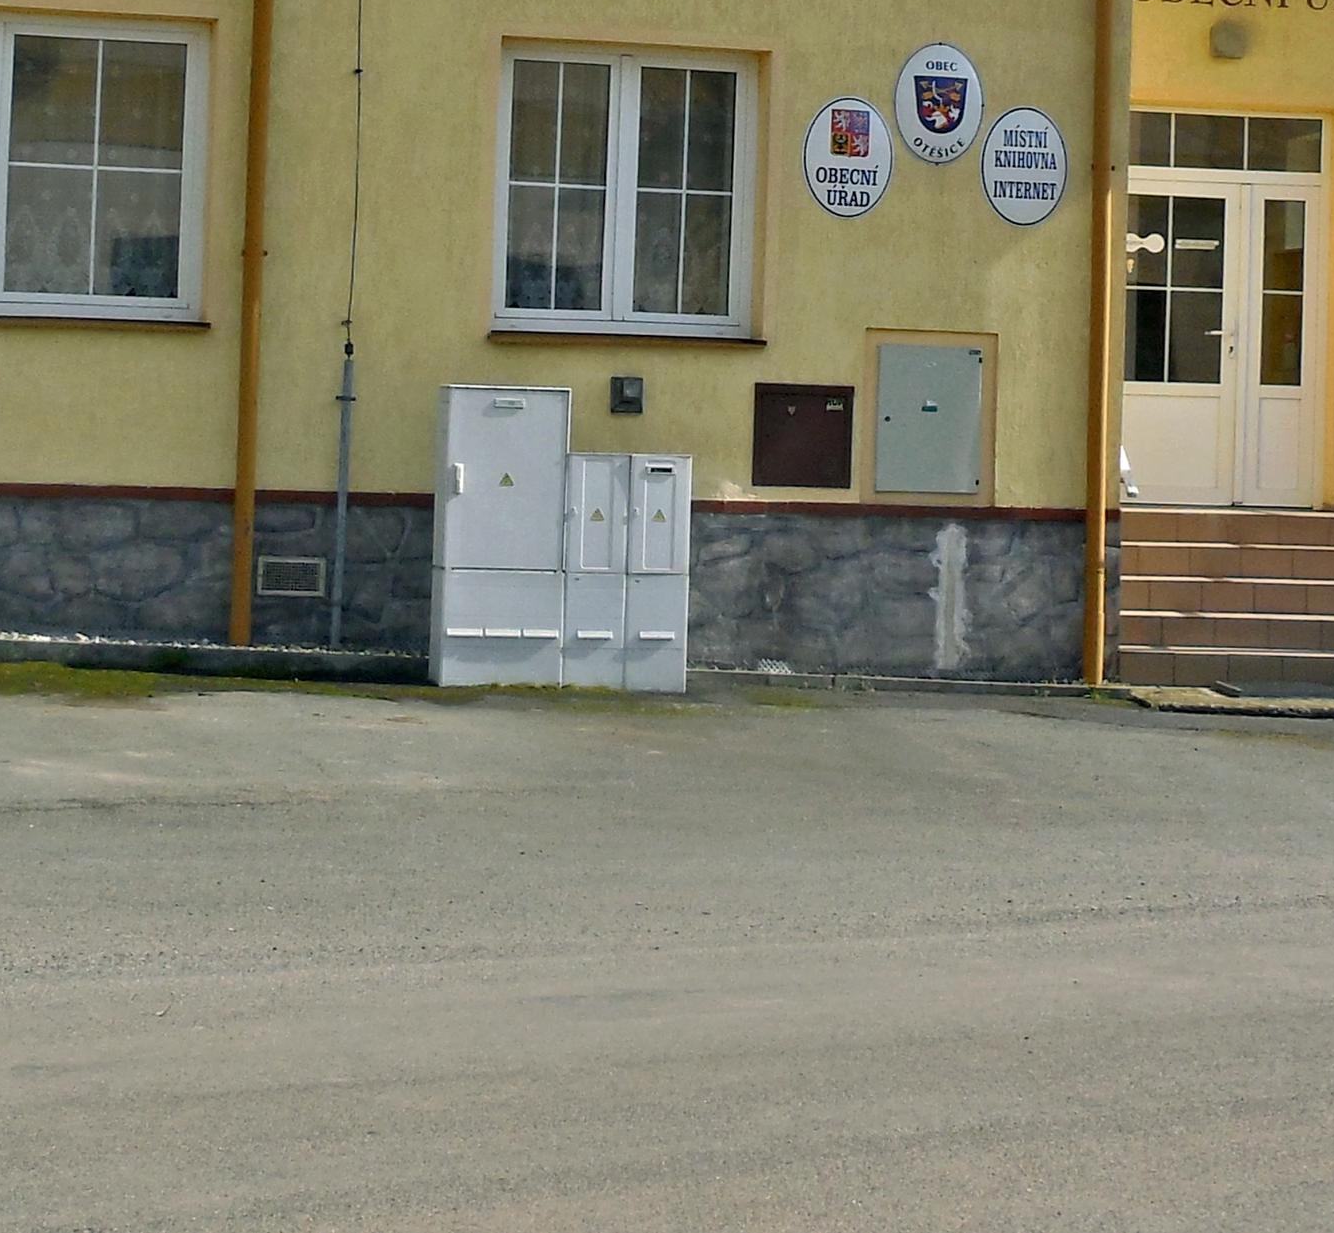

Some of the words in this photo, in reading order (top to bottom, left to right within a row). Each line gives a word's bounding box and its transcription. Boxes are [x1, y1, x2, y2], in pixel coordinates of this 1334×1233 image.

[925, 61, 958, 72] OBEC
[1003, 125, 1049, 150] MÍSTNÍ
[994, 150, 1058, 171] KNIHOVNA
[816, 165, 879, 187] OBECNÍ
[826, 184, 871, 208] ÚŘAD
[992, 180, 1057, 201] INTERNET
